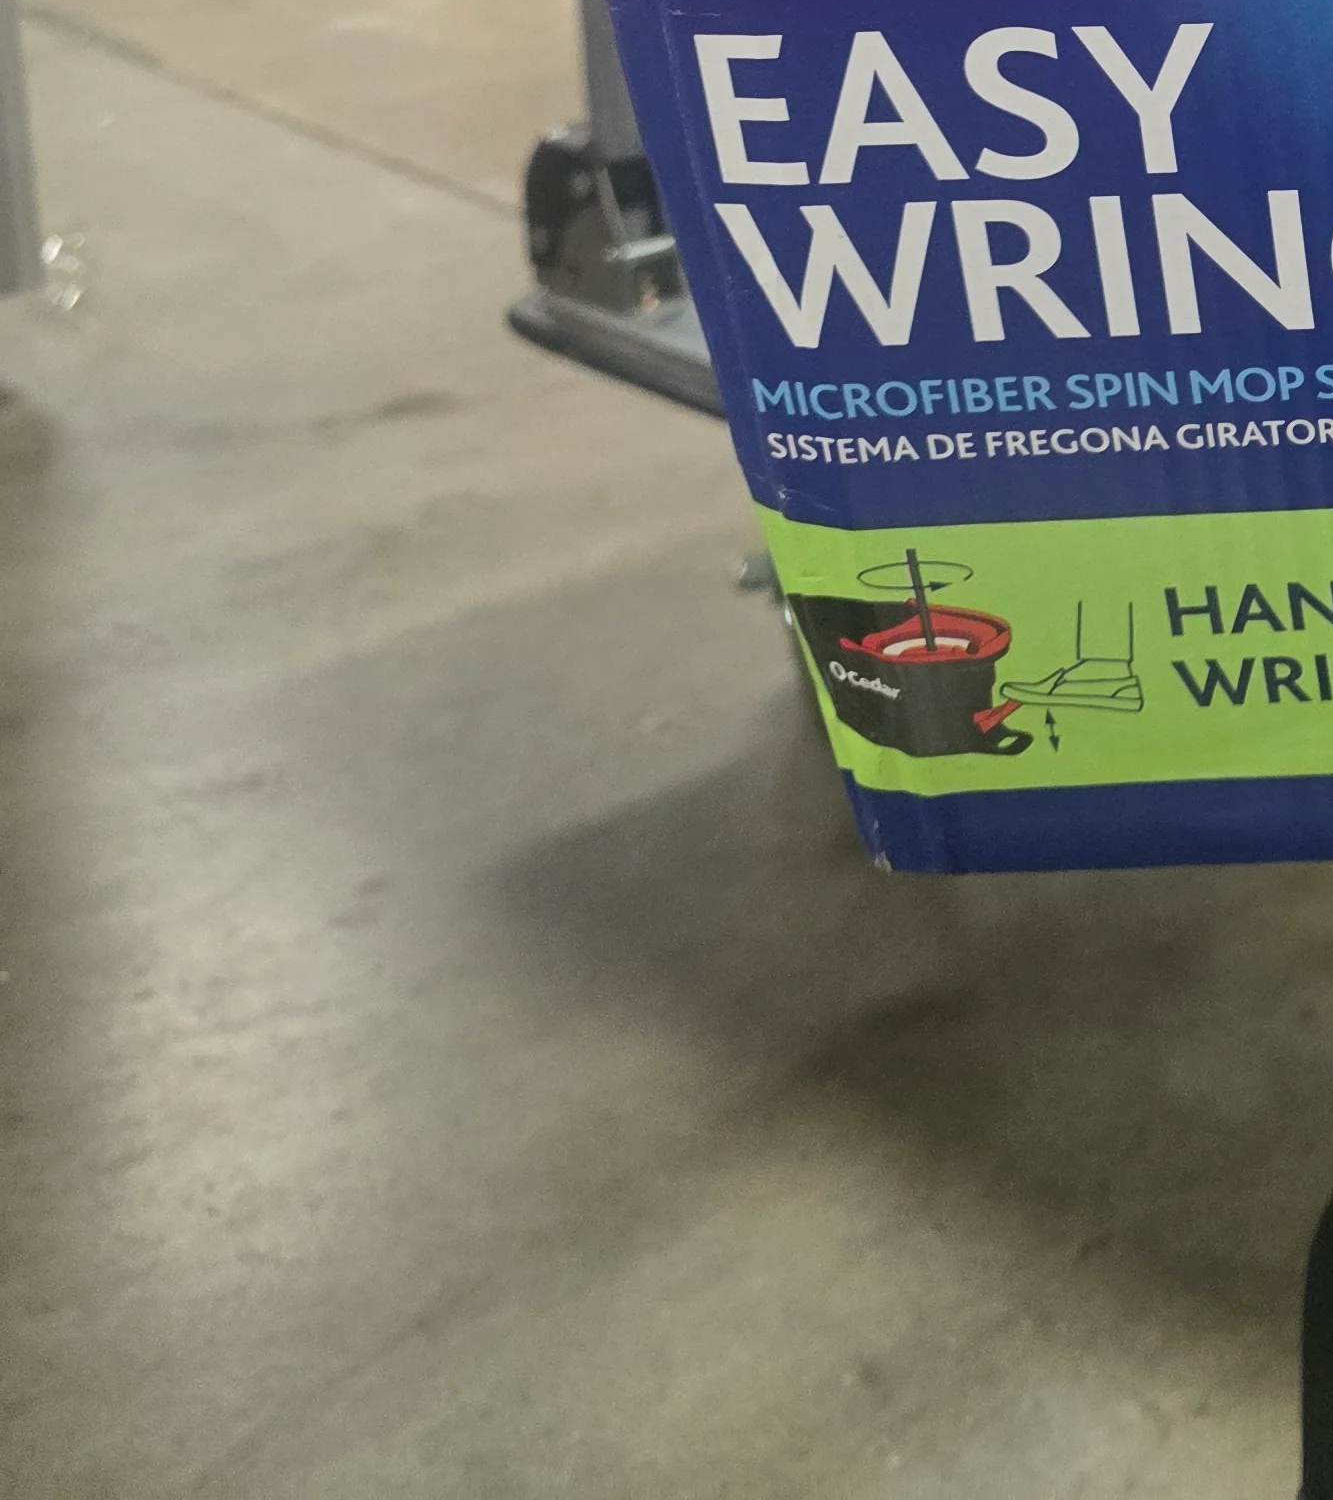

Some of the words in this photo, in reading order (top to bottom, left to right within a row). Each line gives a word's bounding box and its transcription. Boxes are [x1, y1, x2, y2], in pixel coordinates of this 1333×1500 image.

[693, 23, 1214, 187] EASY
[752, 376, 1057, 420] MICROFIBER
[1069, 370, 1180, 410] SPIN
[1190, 367, 1304, 405] MOP
[768, 434, 919, 465] SISTEMA
[928, 431, 978, 462] DE
[986, 426, 1169, 458] FREGONA
